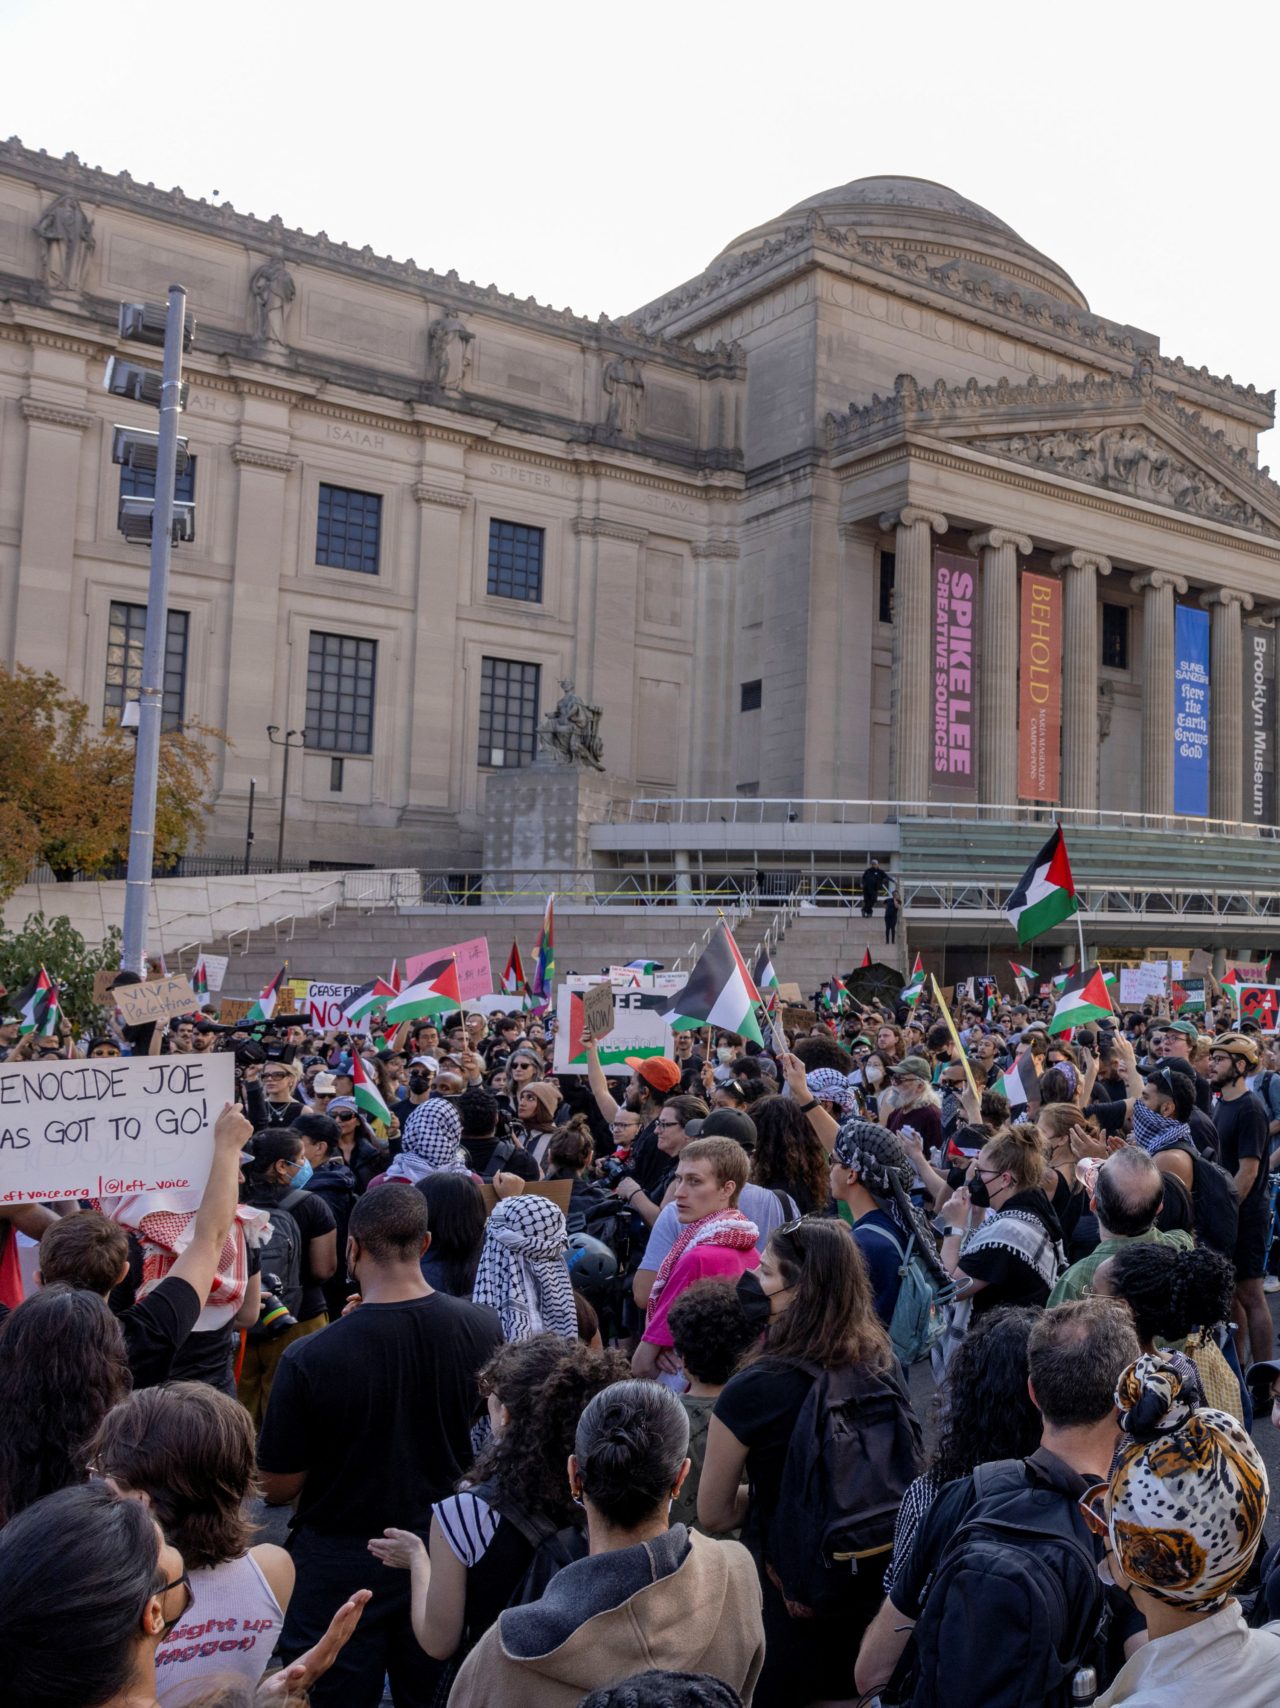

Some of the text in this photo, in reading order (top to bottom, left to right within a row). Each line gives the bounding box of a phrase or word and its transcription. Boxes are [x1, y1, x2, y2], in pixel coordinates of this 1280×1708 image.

[326, 424, 385, 450] ISAIAH
[1030, 583, 1052, 704] BEHOLD
[935, 567, 951, 772] CREATIVE SOURCES
[948, 571, 974, 775] SPIKE LEE
[1181, 683, 1205, 701] Here
[1185, 699, 1202, 715] the
[1177, 713, 1207, 732] Earth
[1252, 636, 1267, 816] Brooklyn Museum
[1175, 728, 1209, 746] Grows
[1180, 743, 1203, 759] Gold
[124, 981, 182, 1000] VIVA
[309, 984, 342, 998] CEASE
[125, 998, 194, 1020] Palestina
[587, 1004, 612, 1034] NOW
[0, 1063, 205, 1104] ENOCIDE JOE
[0, 1098, 209, 1150] AS GOT TO GO!
[0, 1188, 90, 1201] eftvoice.org
[163, 1618, 273, 1644] aight up
